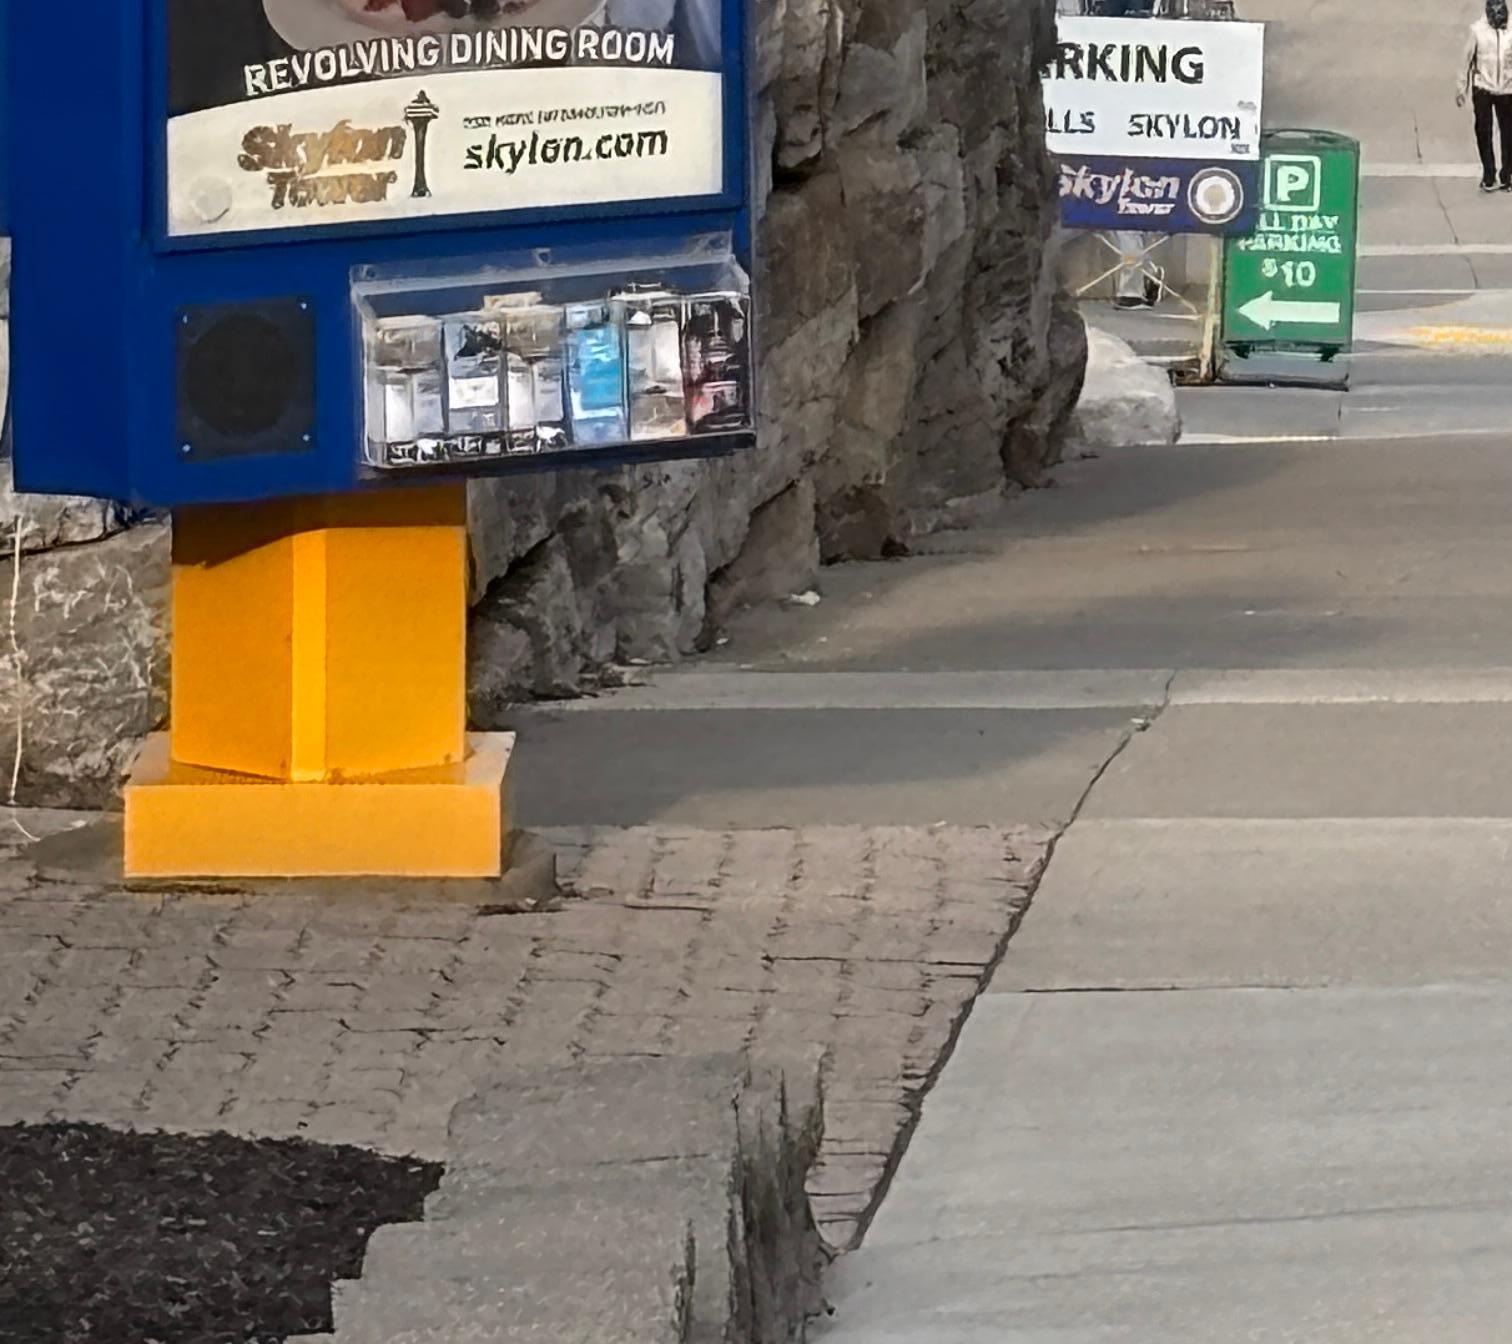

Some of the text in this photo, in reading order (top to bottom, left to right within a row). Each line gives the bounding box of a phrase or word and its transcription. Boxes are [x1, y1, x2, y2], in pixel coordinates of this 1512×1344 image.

[244, 28, 676, 97] REVOLVING DINING ROOM
[1040, 41, 1205, 84] RKING
[1046, 108, 1241, 140] LLS SKYLON
[237, 118, 407, 176] Skylon
[463, 130, 668, 175] skylon.com
[1276, 165, 1310, 202] P
[1256, 212, 1286, 231] LL
